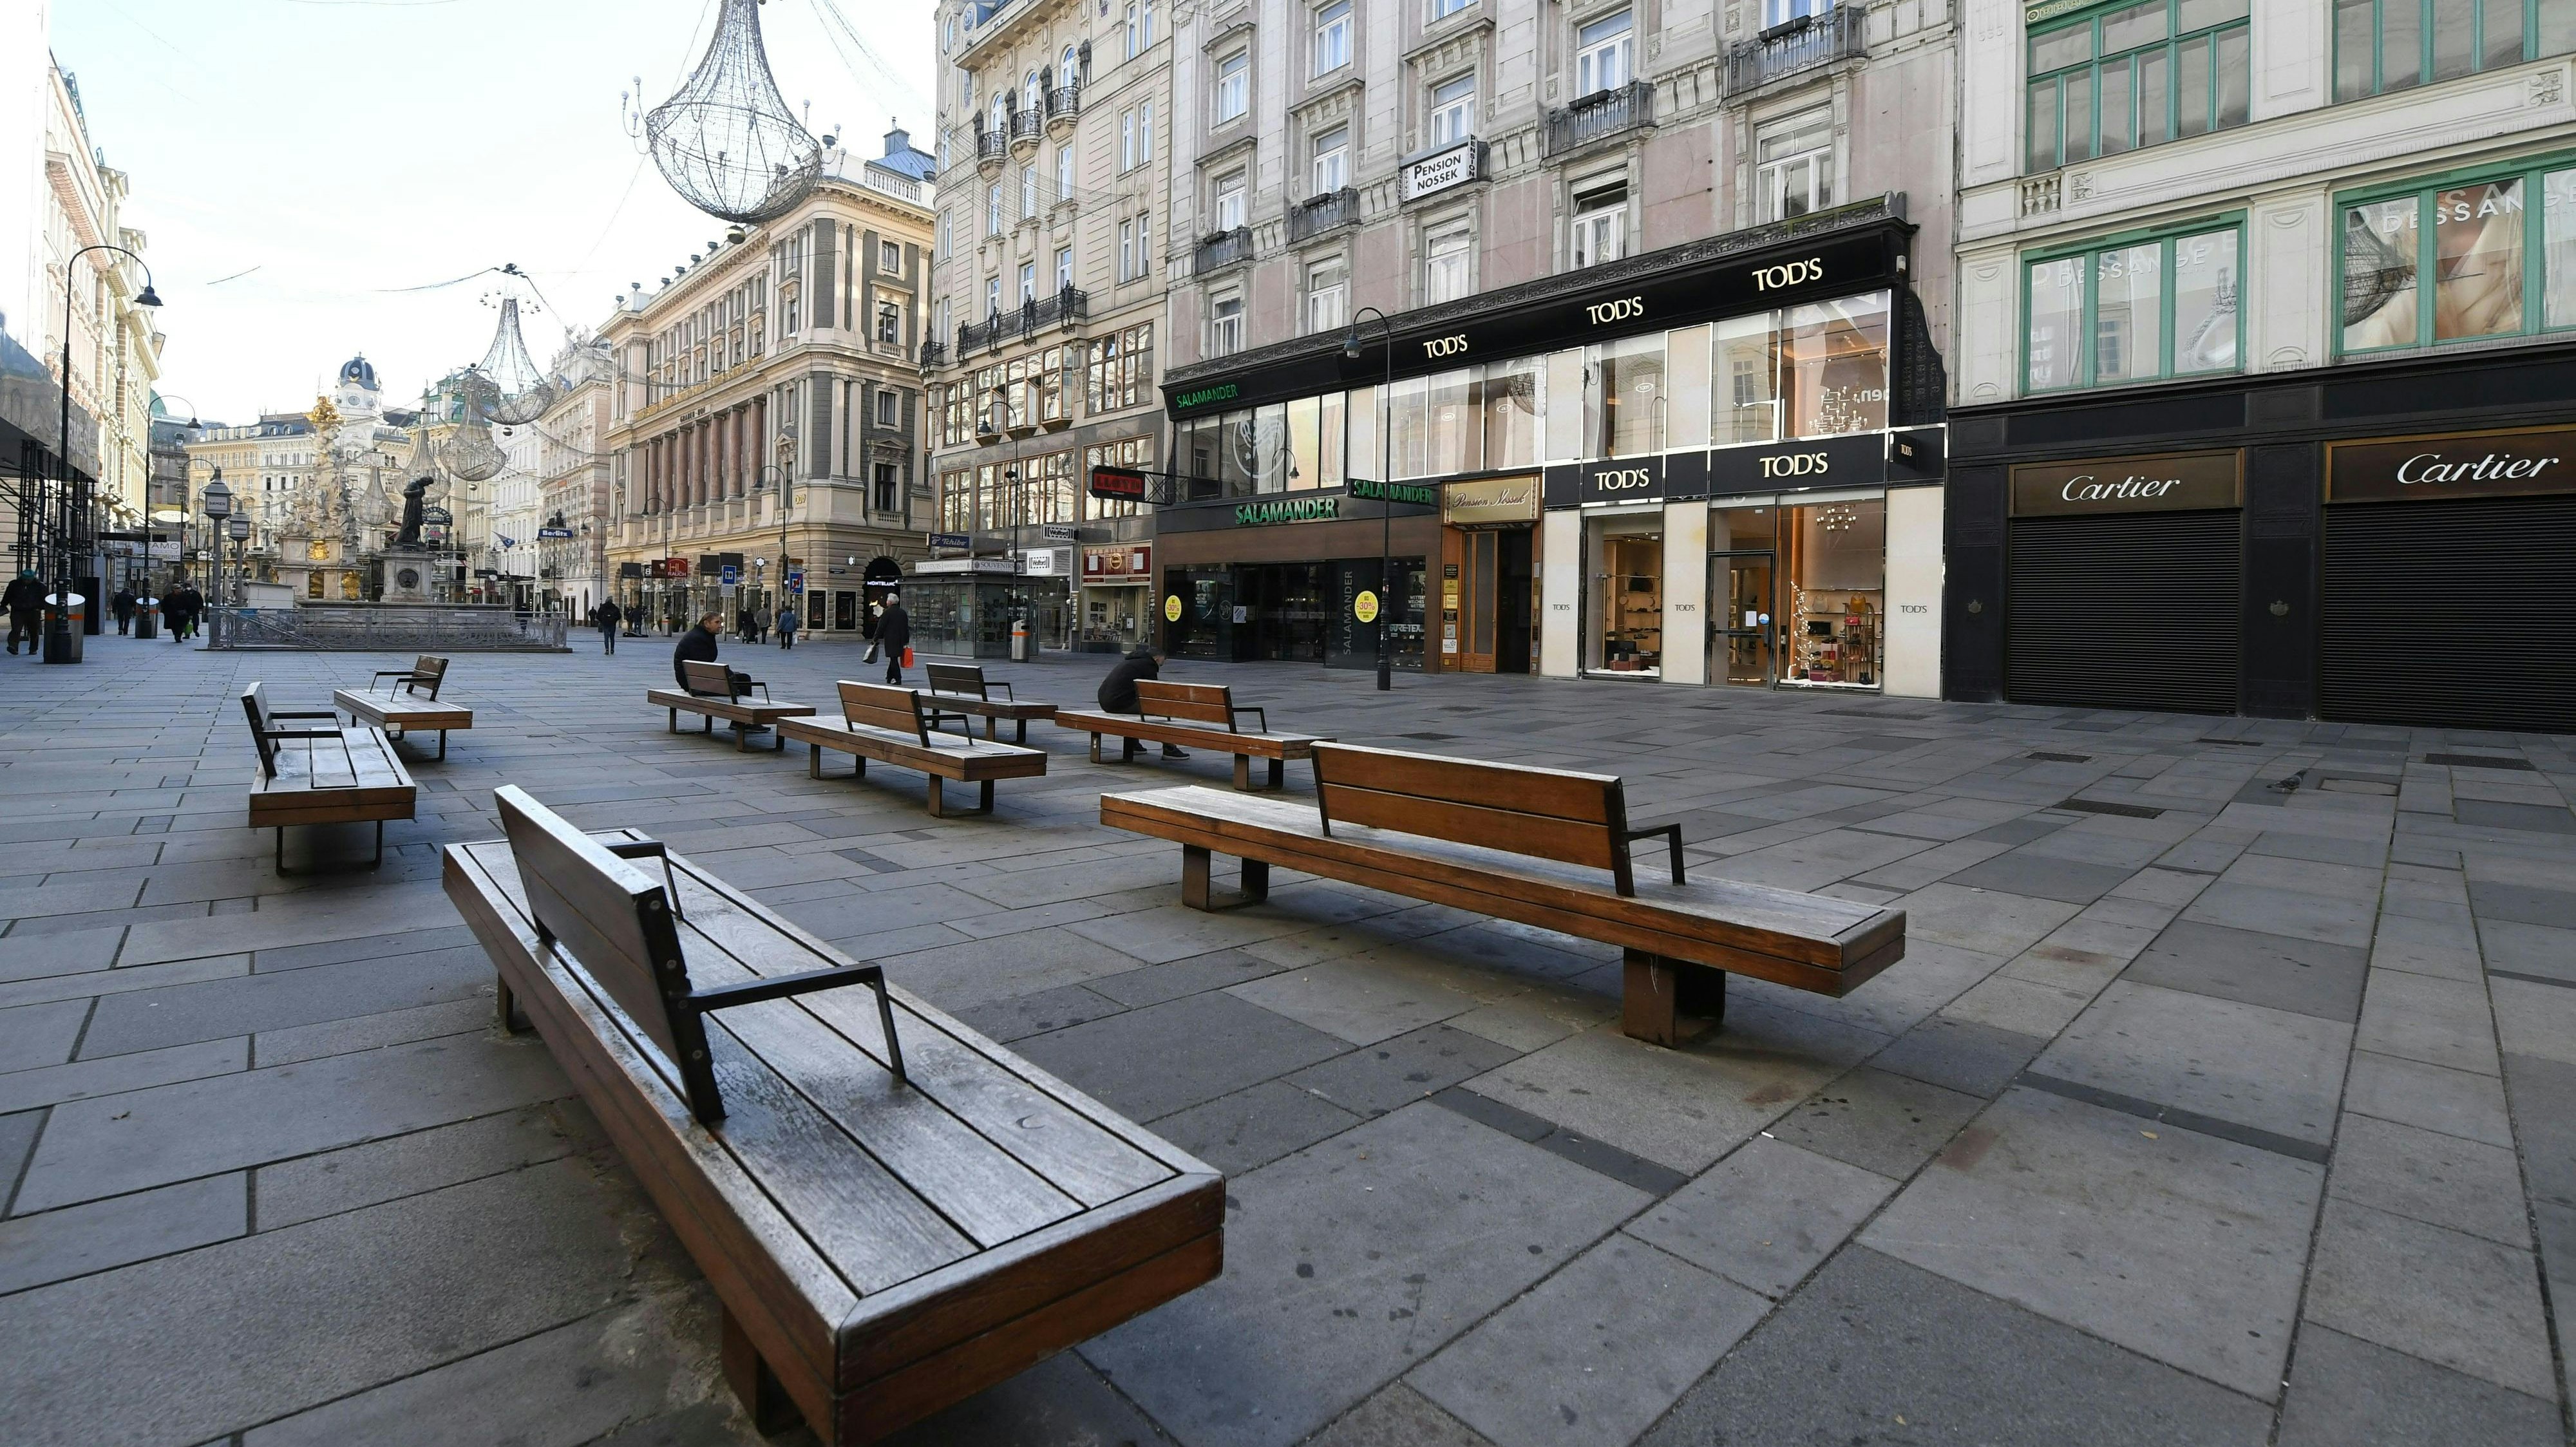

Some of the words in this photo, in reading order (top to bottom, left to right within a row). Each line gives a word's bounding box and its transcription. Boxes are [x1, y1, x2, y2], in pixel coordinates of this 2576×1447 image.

[1414, 155, 1461, 180] PENSION
[1417, 169, 1458, 191] NOSSEK
[1752, 258, 1823, 292] TOD'S
[1586, 296, 1644, 325] TOD'S
[1423, 334, 1468, 359] TOD'S
[1176, 384, 1238, 408] SALAMANDER
[1759, 452, 1829, 478] TOD'S
[2396, 453, 2560, 484] Cartier
[1354, 480, 1433, 504] SALAMANDER
[1595, 468, 1650, 492] TOD'S
[2061, 475, 2181, 502] Cartier
[1453, 492, 1490, 508] Pension
[1491, 488, 1530, 506] Nossek
[1235, 498, 1337, 524] SALAMANDER
[942, 538, 967, 546] Tchibo
[1032, 558, 1046, 567] Wolford
[1343, 571, 1353, 656] SALAMANDER
[1356, 601, 1376, 610] -30%
[1900, 605, 1928, 614] TOD'S
